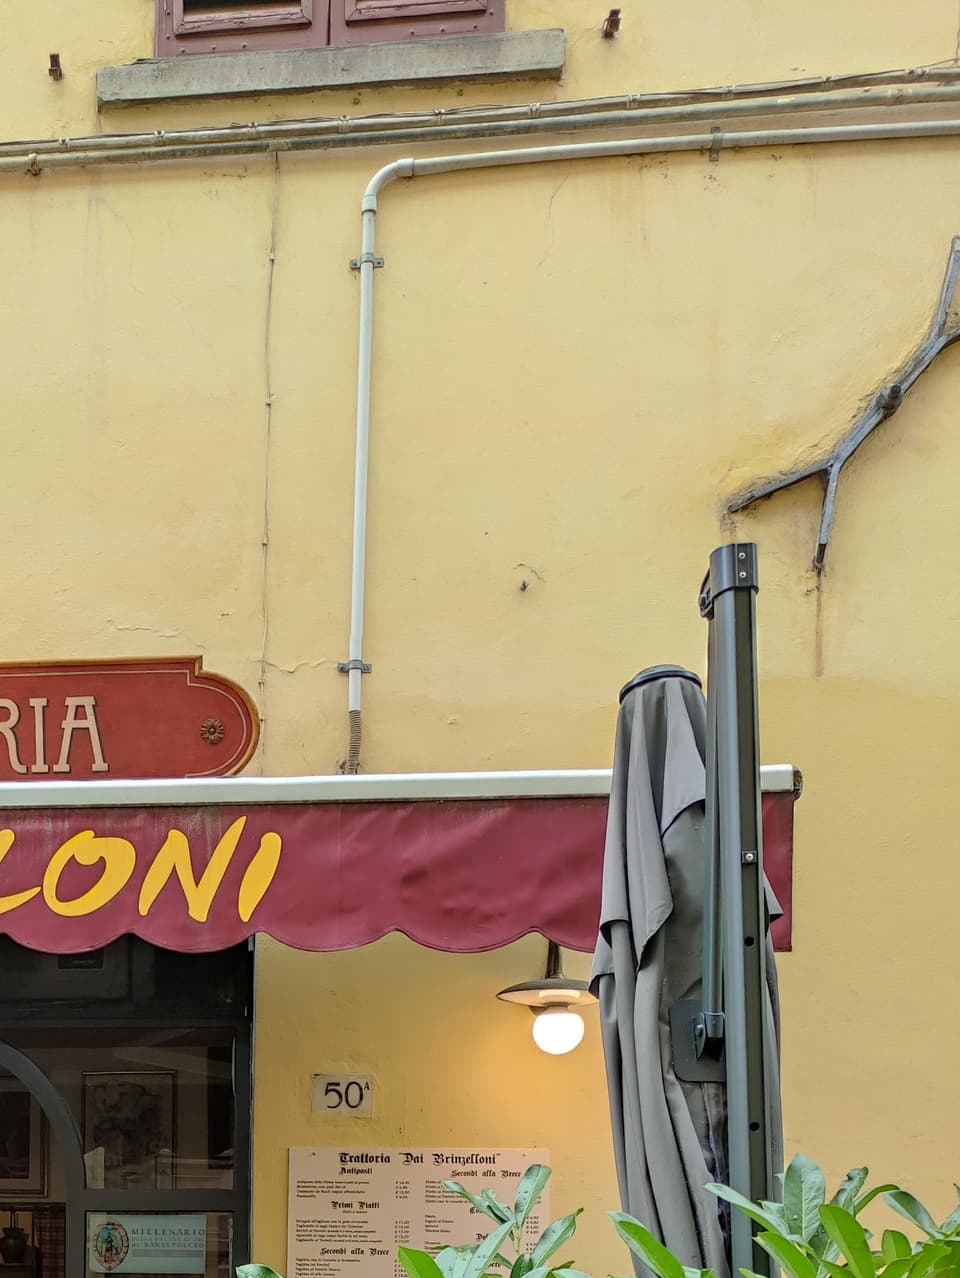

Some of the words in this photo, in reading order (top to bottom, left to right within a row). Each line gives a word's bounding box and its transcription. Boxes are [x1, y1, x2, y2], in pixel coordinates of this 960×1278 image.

[339, 1152, 391, 1166] Trattoria
[331, 1200, 354, 1210] Primi
[358, 1201, 380, 1210] Piatti
[131, 1228, 205, 1236] MILLENARIO
[351, 1248, 365, 1256] alla
